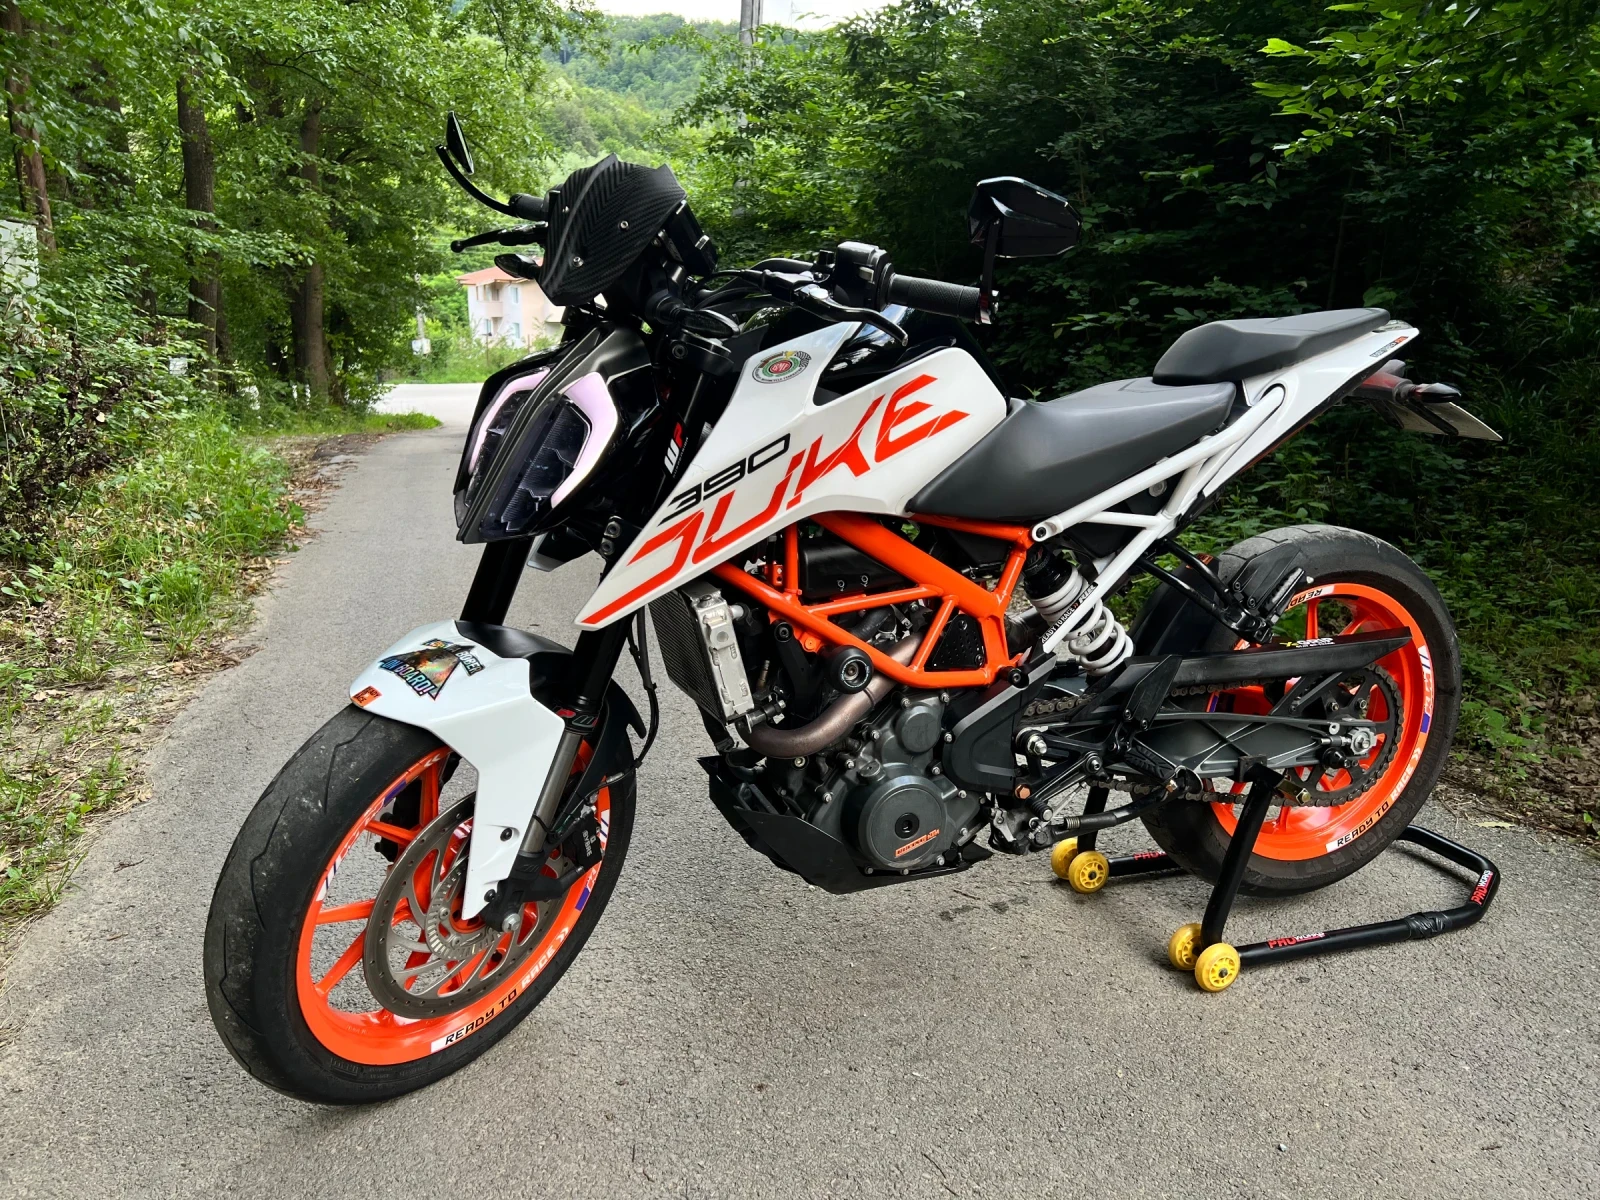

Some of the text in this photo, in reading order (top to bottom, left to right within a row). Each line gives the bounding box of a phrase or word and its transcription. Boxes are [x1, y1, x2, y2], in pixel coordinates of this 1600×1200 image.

[581, 373, 970, 624] DUKE
[657, 433, 791, 528] 390
[581, 829, 593, 858] BYBRE
[1337, 766, 1414, 847] READY TO RACE
[445, 946, 555, 1046] READY TO RACE
